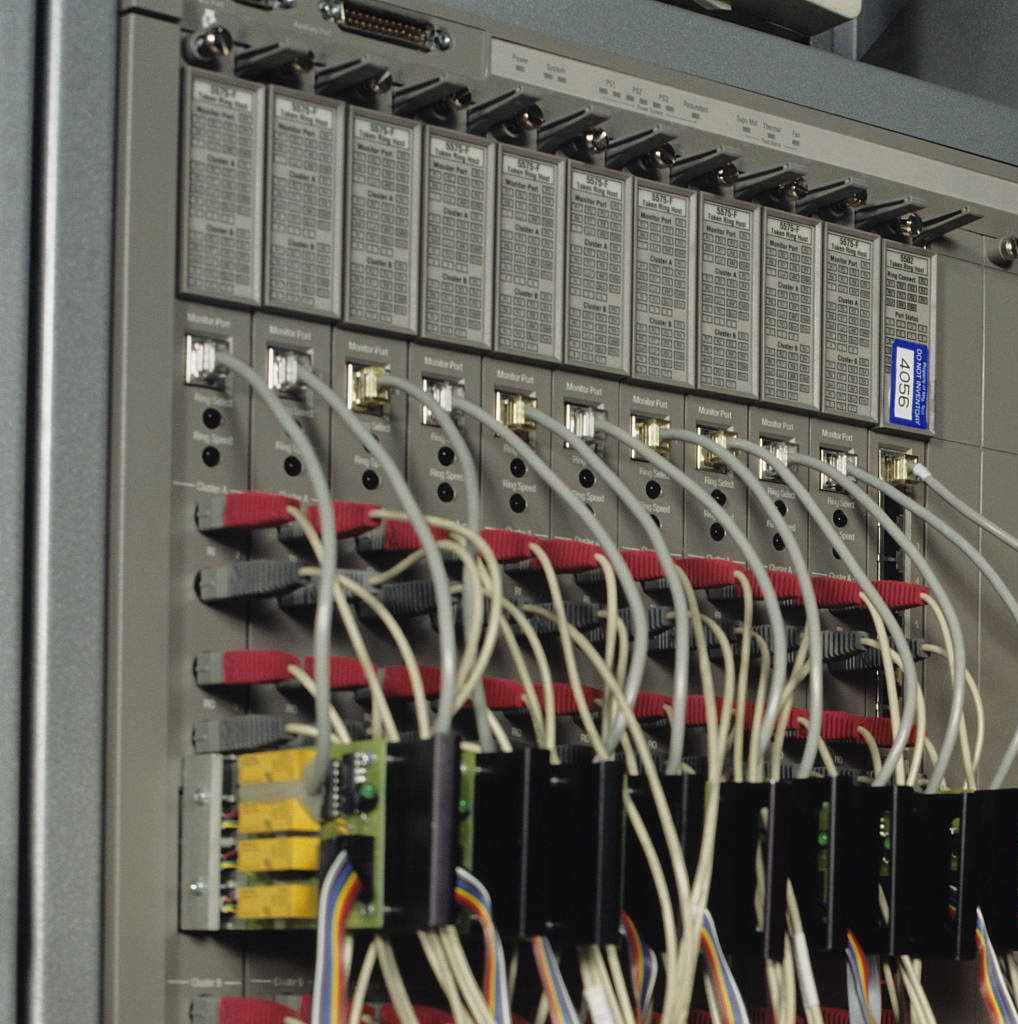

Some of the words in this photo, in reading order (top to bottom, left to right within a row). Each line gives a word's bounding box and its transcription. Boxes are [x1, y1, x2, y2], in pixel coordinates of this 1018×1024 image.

[651, 192, 672, 205] 5575-F
[716, 206, 736, 218] 5575-F
[779, 221, 799, 233] 5575-F
[916, 348, 922, 360] DO
[497, 370, 520, 382] Monitor
[521, 374, 534, 384] Port
[898, 358, 910, 408] 4056
[566, 382, 588, 394] Monitor
[590, 386, 602, 396] Port
[633, 396, 654, 406] Monitor
[655, 399, 668, 408] Port
[698, 406, 719, 417] Monitor
[720, 410, 732, 419] Port
[762, 418, 782, 428] Monitor
[782, 421, 794, 431] Port
[822, 429, 841, 439] Monitor
[842, 432, 853, 442] Port
